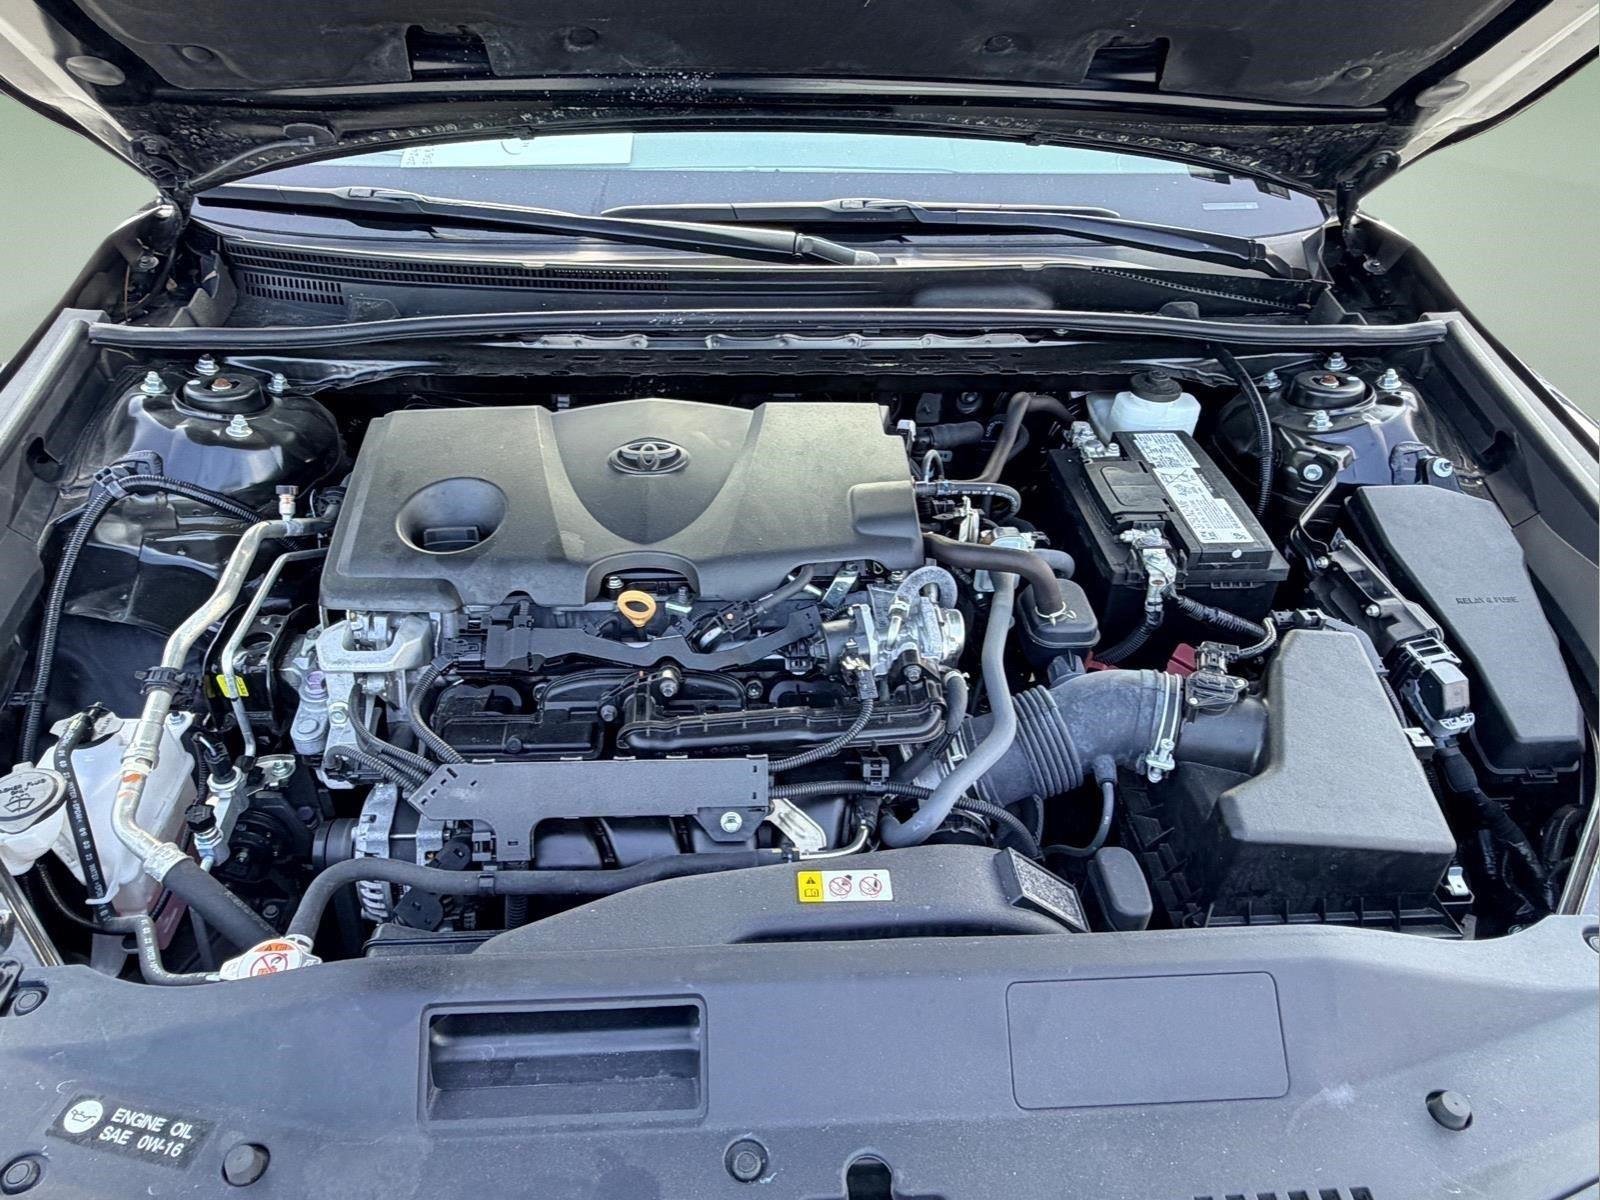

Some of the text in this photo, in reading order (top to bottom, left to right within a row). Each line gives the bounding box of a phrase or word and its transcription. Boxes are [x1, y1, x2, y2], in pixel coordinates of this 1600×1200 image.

[110, 1107, 193, 1140] ENGINE OIL
[99, 1125, 185, 1157] SAE 0W-16
